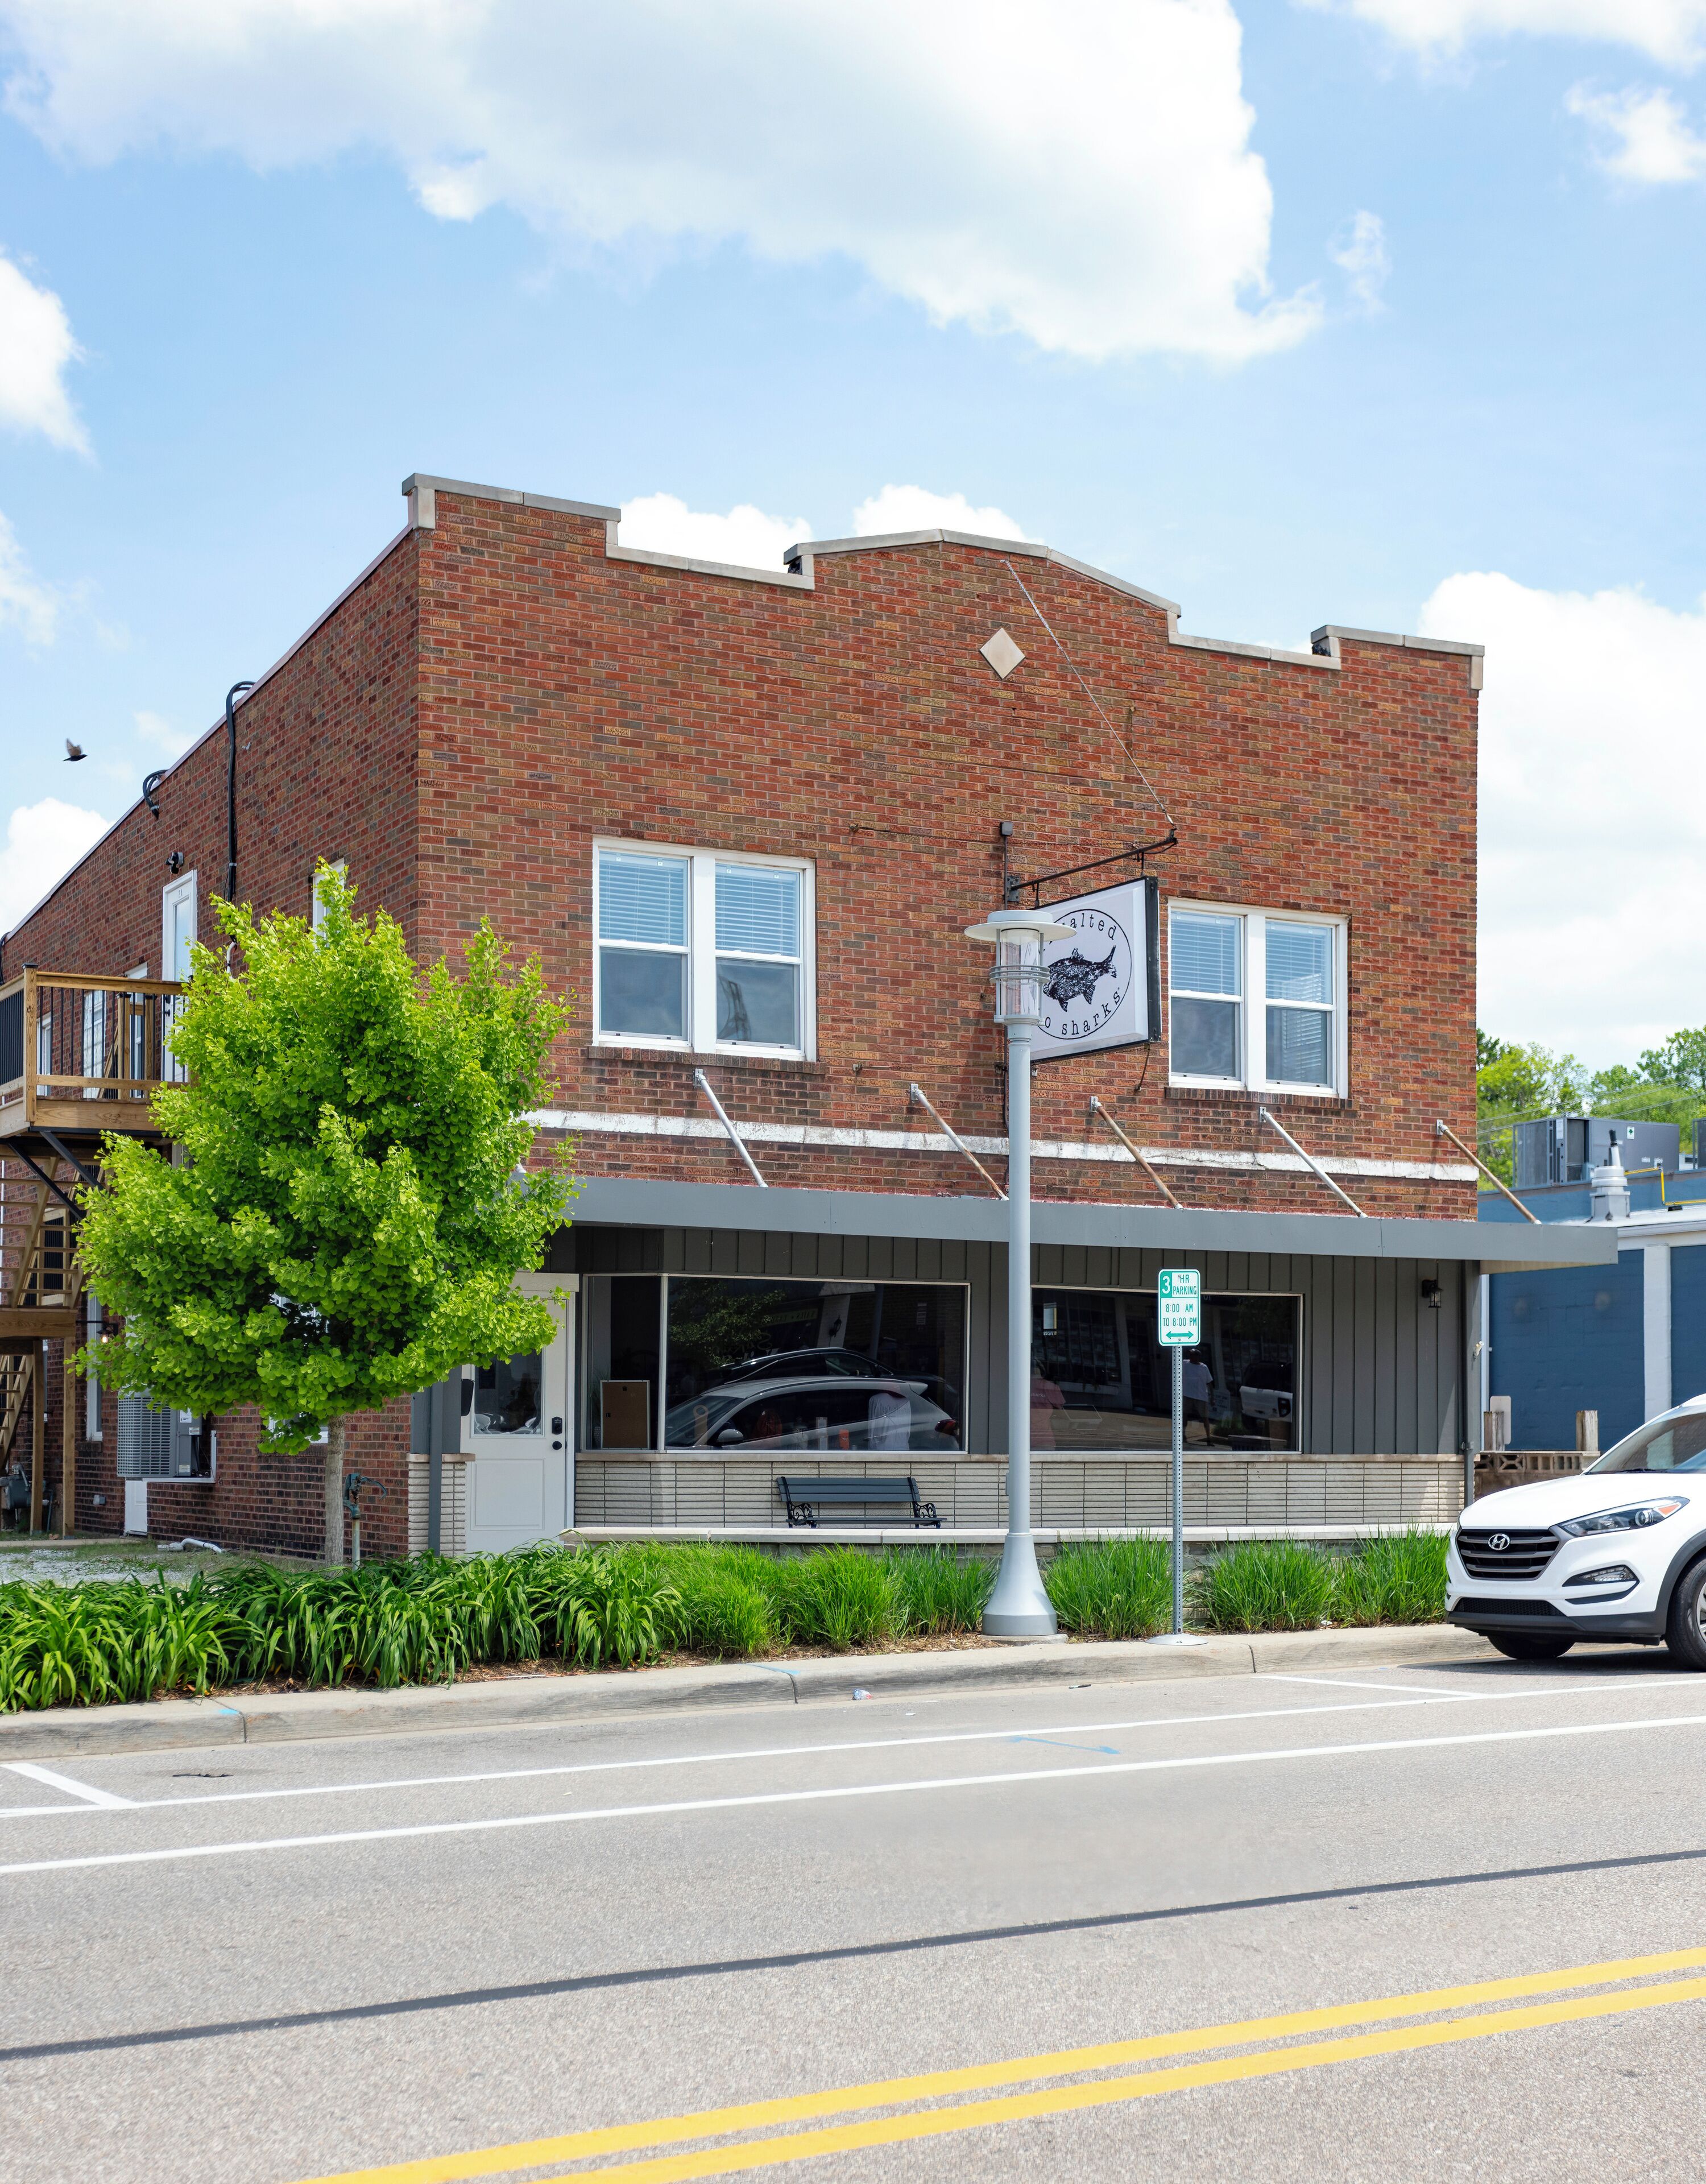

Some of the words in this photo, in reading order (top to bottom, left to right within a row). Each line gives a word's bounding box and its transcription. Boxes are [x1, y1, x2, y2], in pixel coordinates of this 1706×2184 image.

[1061, 913, 1116, 941] alted
[1061, 990, 1121, 1035] sharks
[1179, 1274, 1190, 1283] HR
[1162, 1275, 1171, 1294] 3
[1173, 1286, 1197, 1295] PARKING
[1166, 1304, 1179, 1312] 8:00
[1185, 1304, 1193, 1312] AM
[1162, 1317, 1170, 1326] TO
[1173, 1317, 1186, 1326] 8:00
[1189, 1317, 1197, 1326] PM
